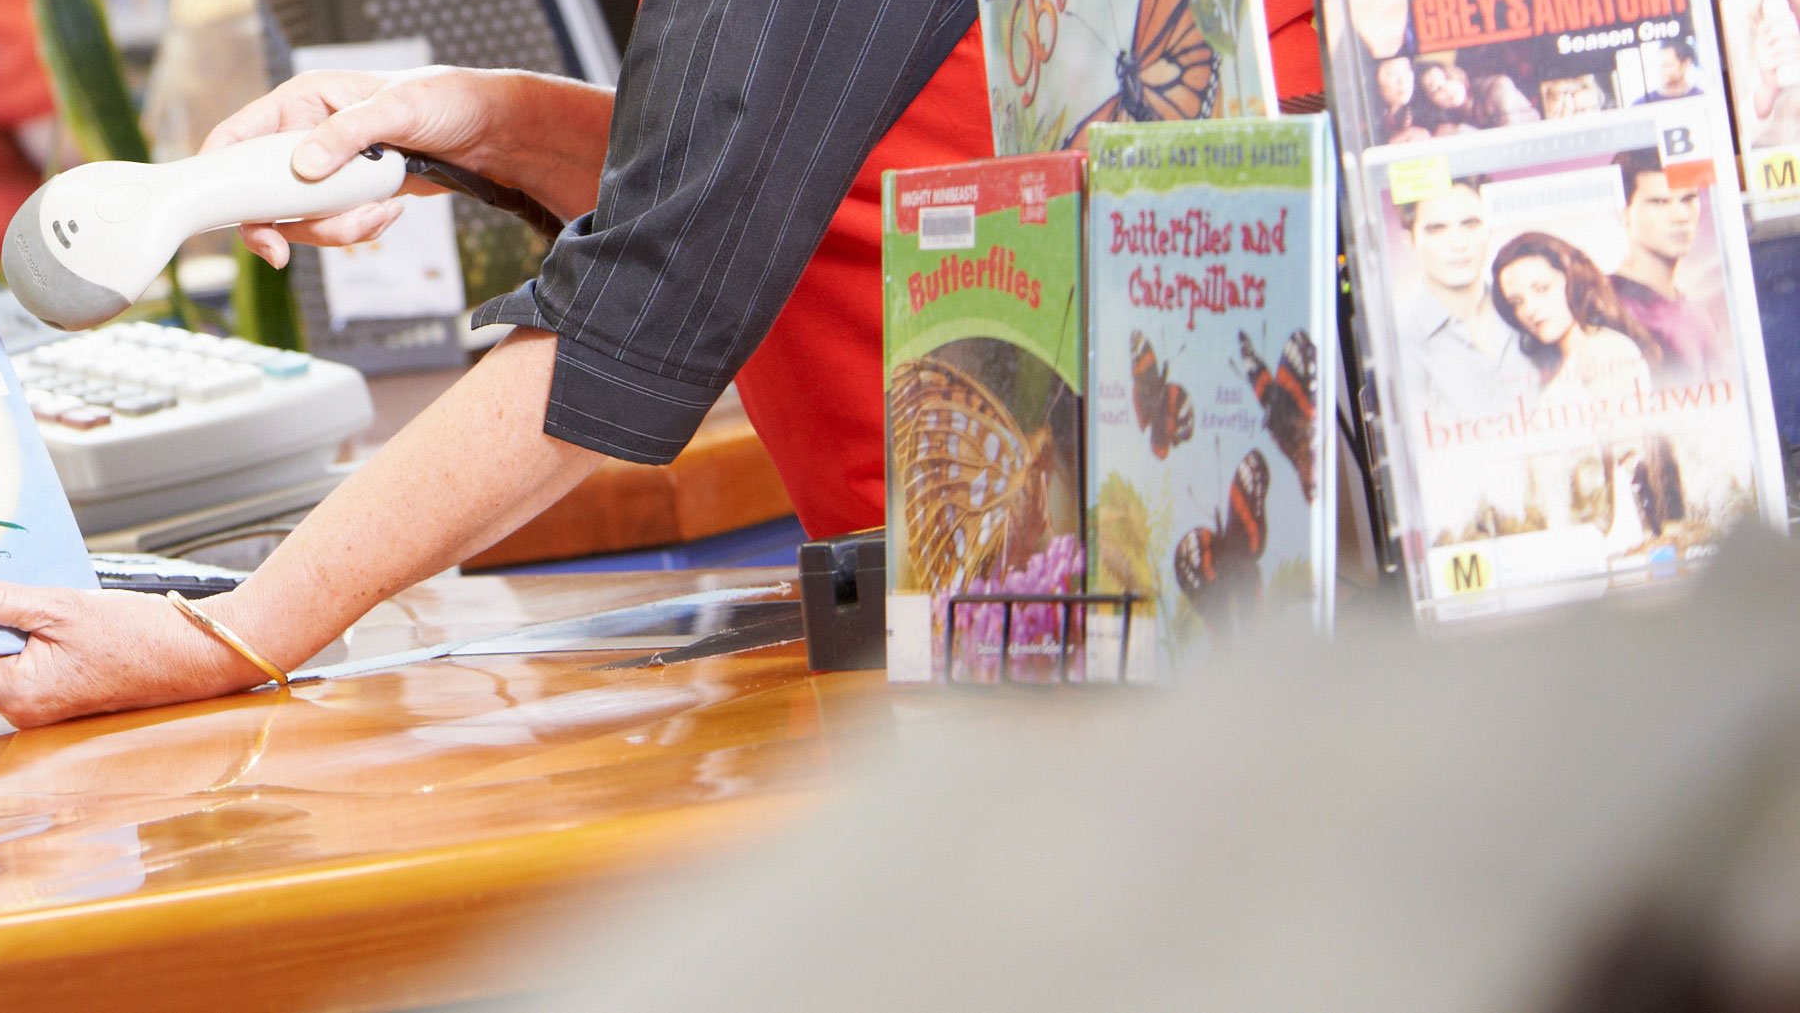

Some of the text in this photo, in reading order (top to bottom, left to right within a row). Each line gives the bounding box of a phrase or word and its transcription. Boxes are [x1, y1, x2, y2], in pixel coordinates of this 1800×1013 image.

[1557, 20, 1680, 55] Season One
[1169, 145, 1198, 168] AND
[1663, 127, 1694, 156] B
[1763, 160, 1796, 189] M
[901, 185, 979, 207] MIGHTY MINIBEASTS
[1110, 206, 1287, 257] Butterflies and
[908, 245, 1042, 316] Butterflies
[1129, 264, 1266, 331] Caterpillars
[1424, 376, 1734, 449] breaking dawn
[1452, 553, 1482, 590] M
